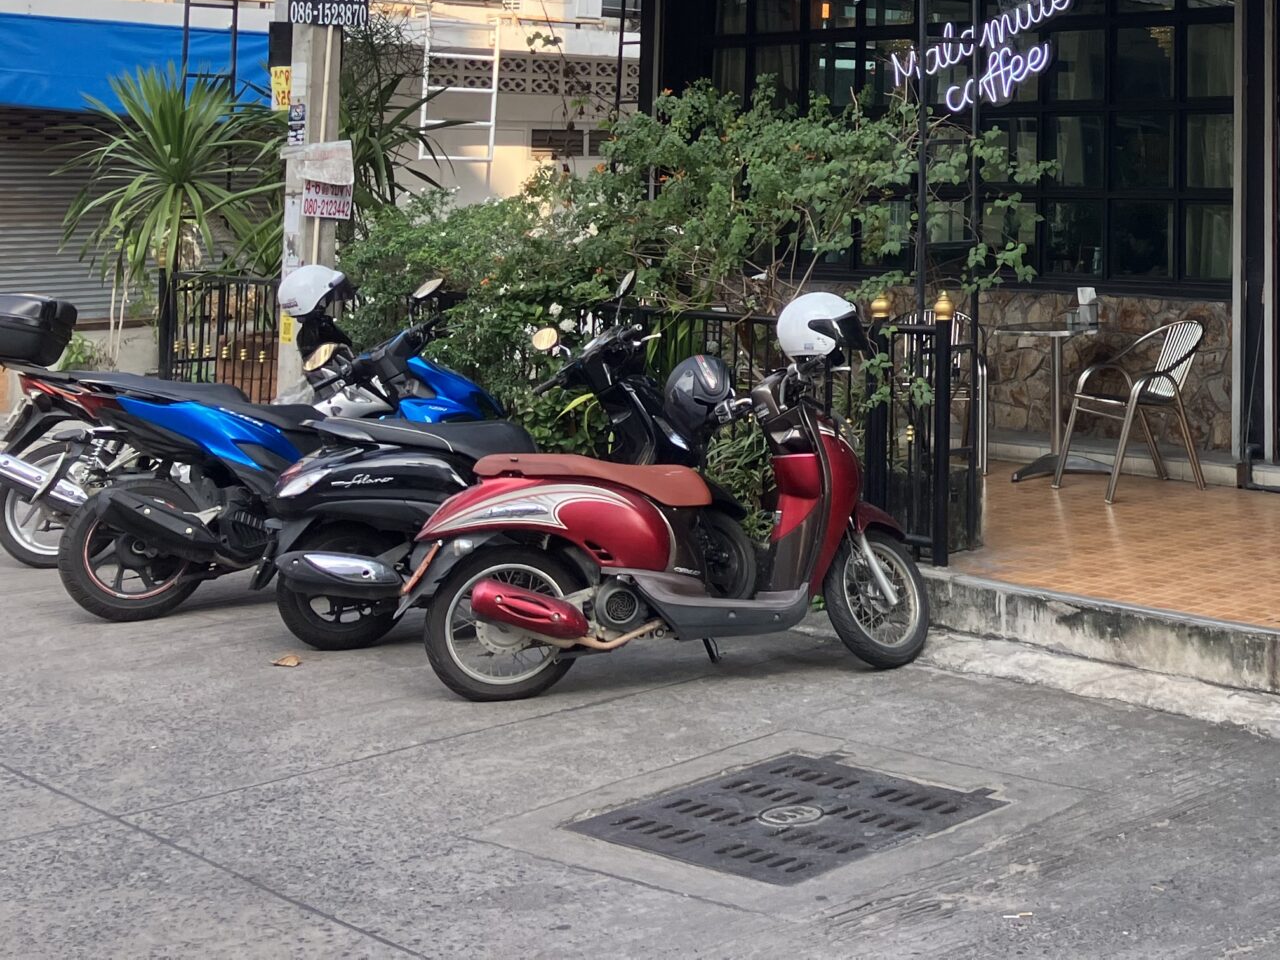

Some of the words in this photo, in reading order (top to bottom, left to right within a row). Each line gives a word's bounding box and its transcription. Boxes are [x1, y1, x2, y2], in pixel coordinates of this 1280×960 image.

[290, 1, 367, 26] 086-1523870
[946, 43, 1049, 112] coffee
[303, 198, 350, 217] 080-2123442
